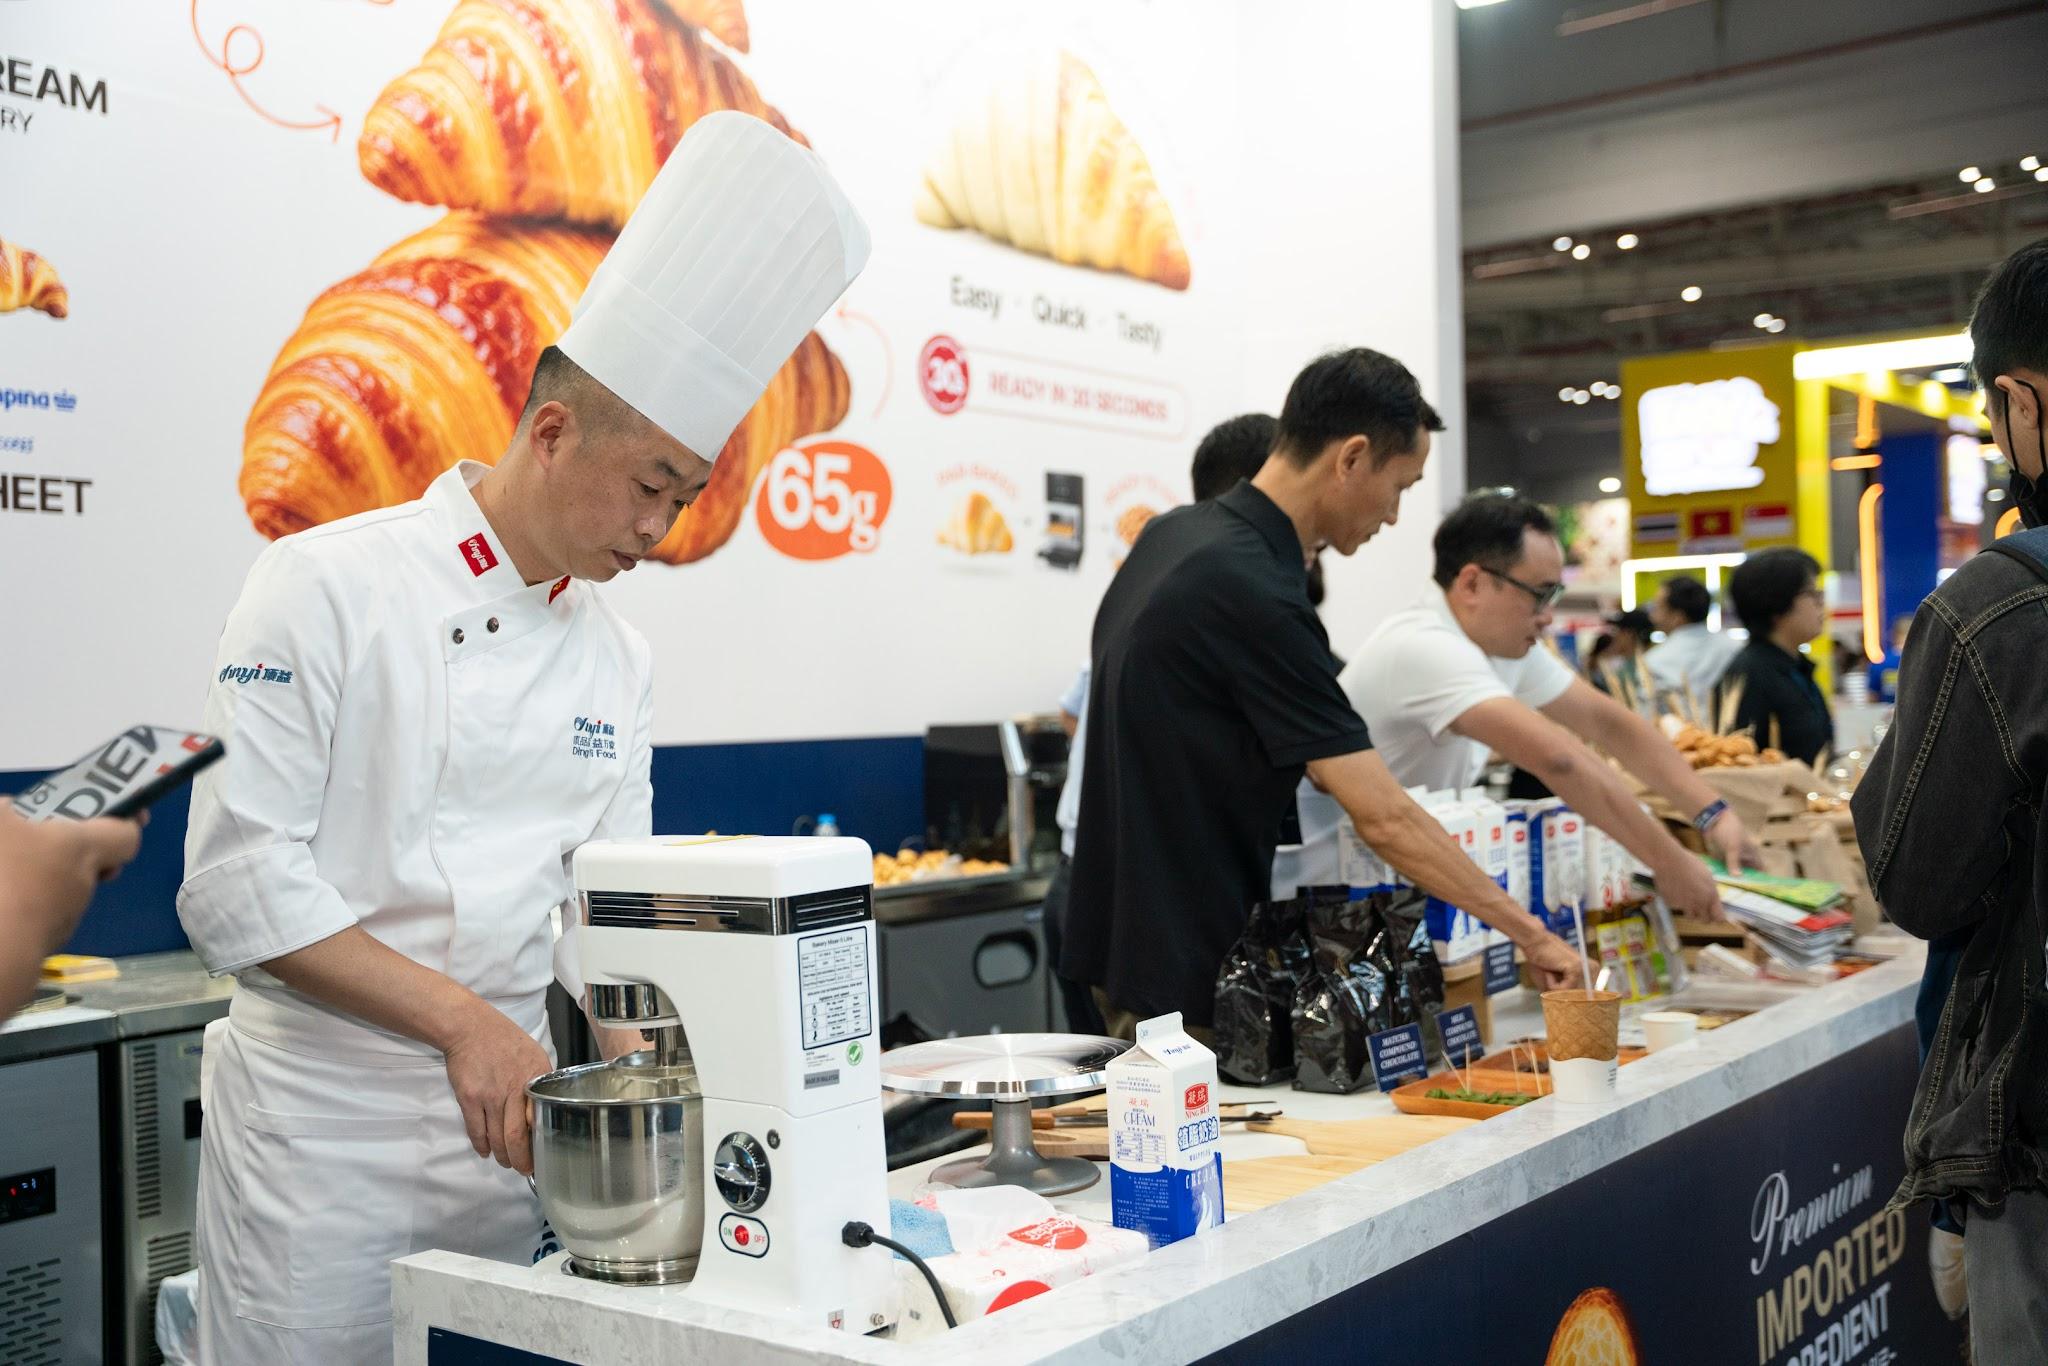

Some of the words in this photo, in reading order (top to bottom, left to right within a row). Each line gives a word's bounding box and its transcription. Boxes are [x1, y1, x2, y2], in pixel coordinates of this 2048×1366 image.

[0, 57, 107, 114] EAM
[950, 274, 1002, 319] Easy
[1032, 294, 1086, 330] Quick
[1116, 313, 1161, 352] Tasty
[989, 370, 1046, 400] READY
[1097, 391, 1168, 420] SECONDS
[768, 450, 878, 551] 65g
[596, 749, 617, 760] Food
[1380, 1041, 1418, 1060] COMPOUND
[1381, 1032, 1411, 1047] MATCHA
[1380, 1051, 1419, 1071] CHOCOLATE
[1124, 1112, 1155, 1127] CREAM
[1177, 1116, 1219, 1152] 植脂奶油
[723, 1227, 733, 1236] ON
[754, 1234, 766, 1244] OFF
[1751, 1163, 1873, 1275] Premium
[1756, 1209, 1906, 1366] IMPORTED
